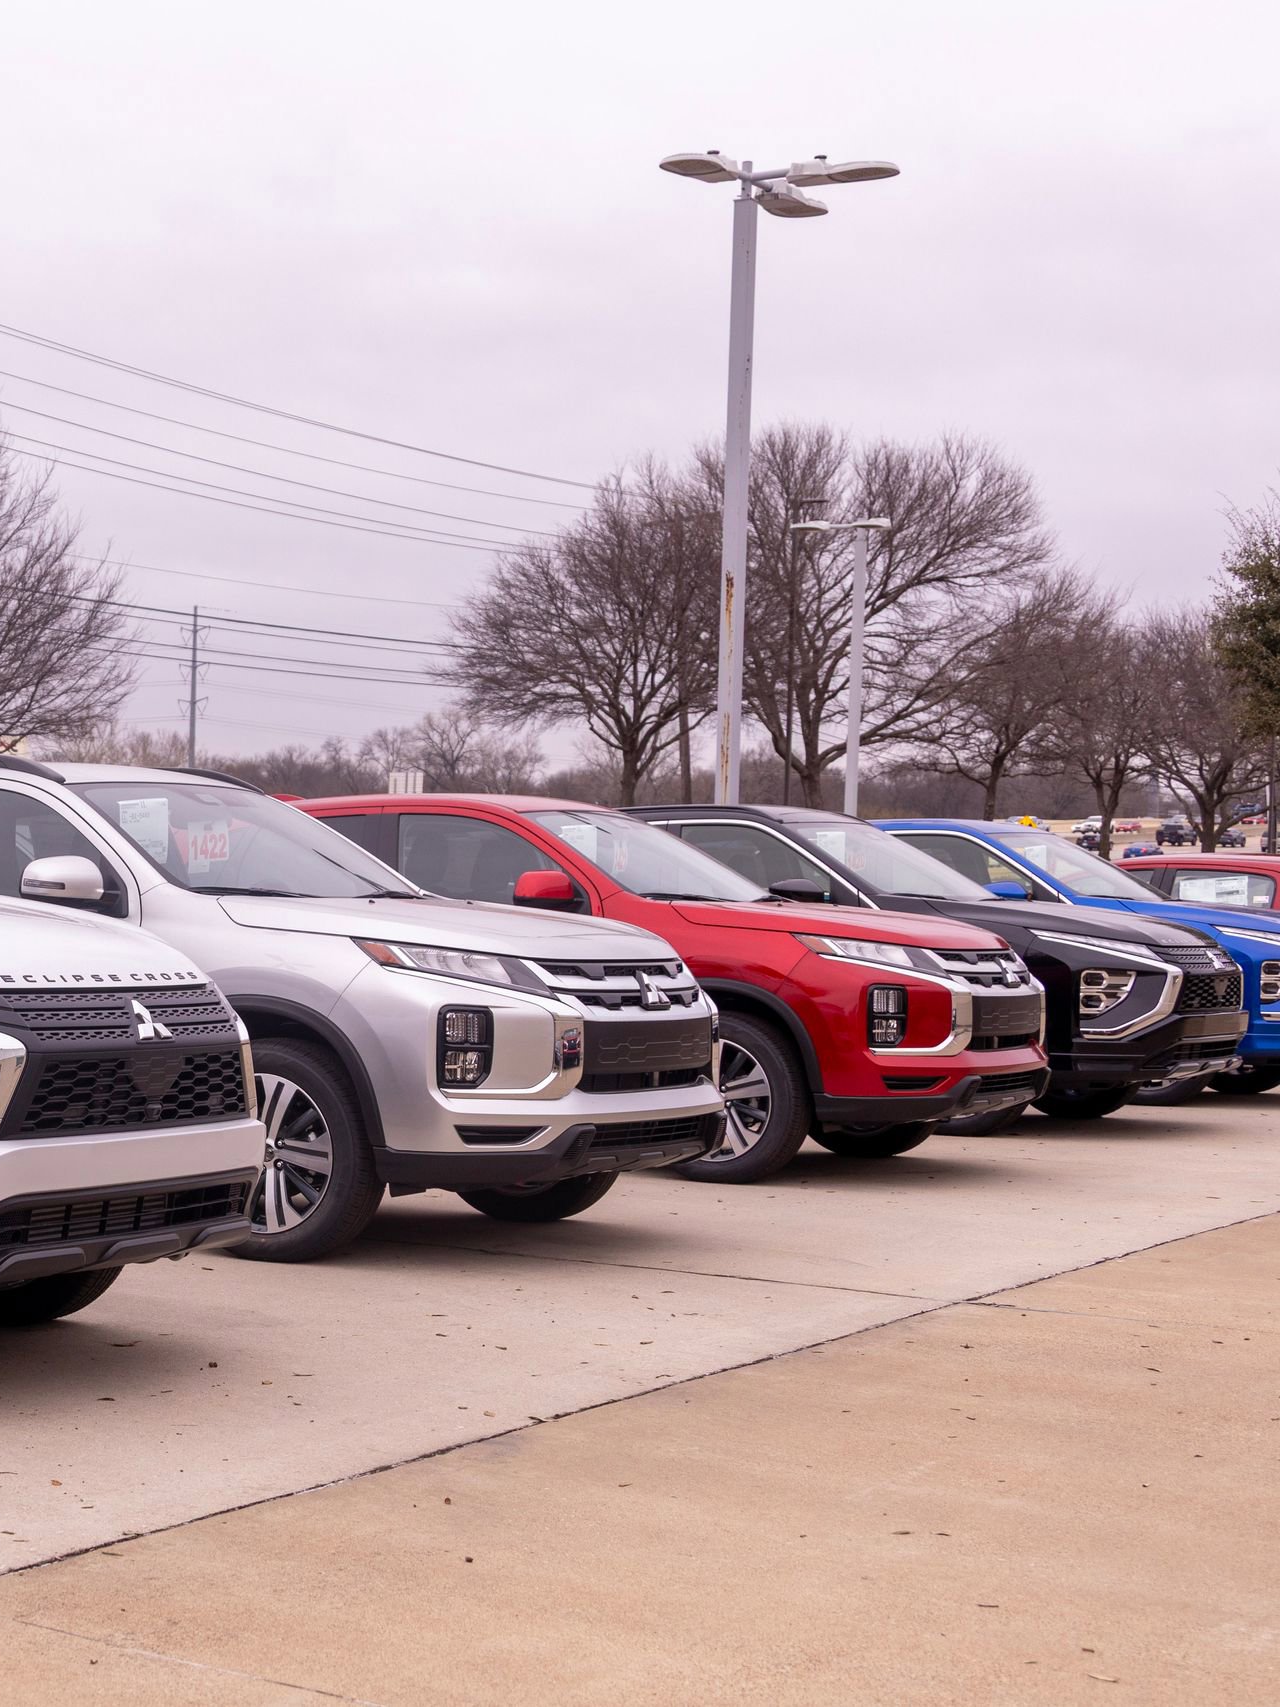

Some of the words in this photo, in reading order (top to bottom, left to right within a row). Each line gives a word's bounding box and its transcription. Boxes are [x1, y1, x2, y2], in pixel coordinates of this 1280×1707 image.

[191, 833, 228, 861] 1422
[0, 974, 122, 983] ECLIPSE
[130, 971, 199, 982] CROSS
